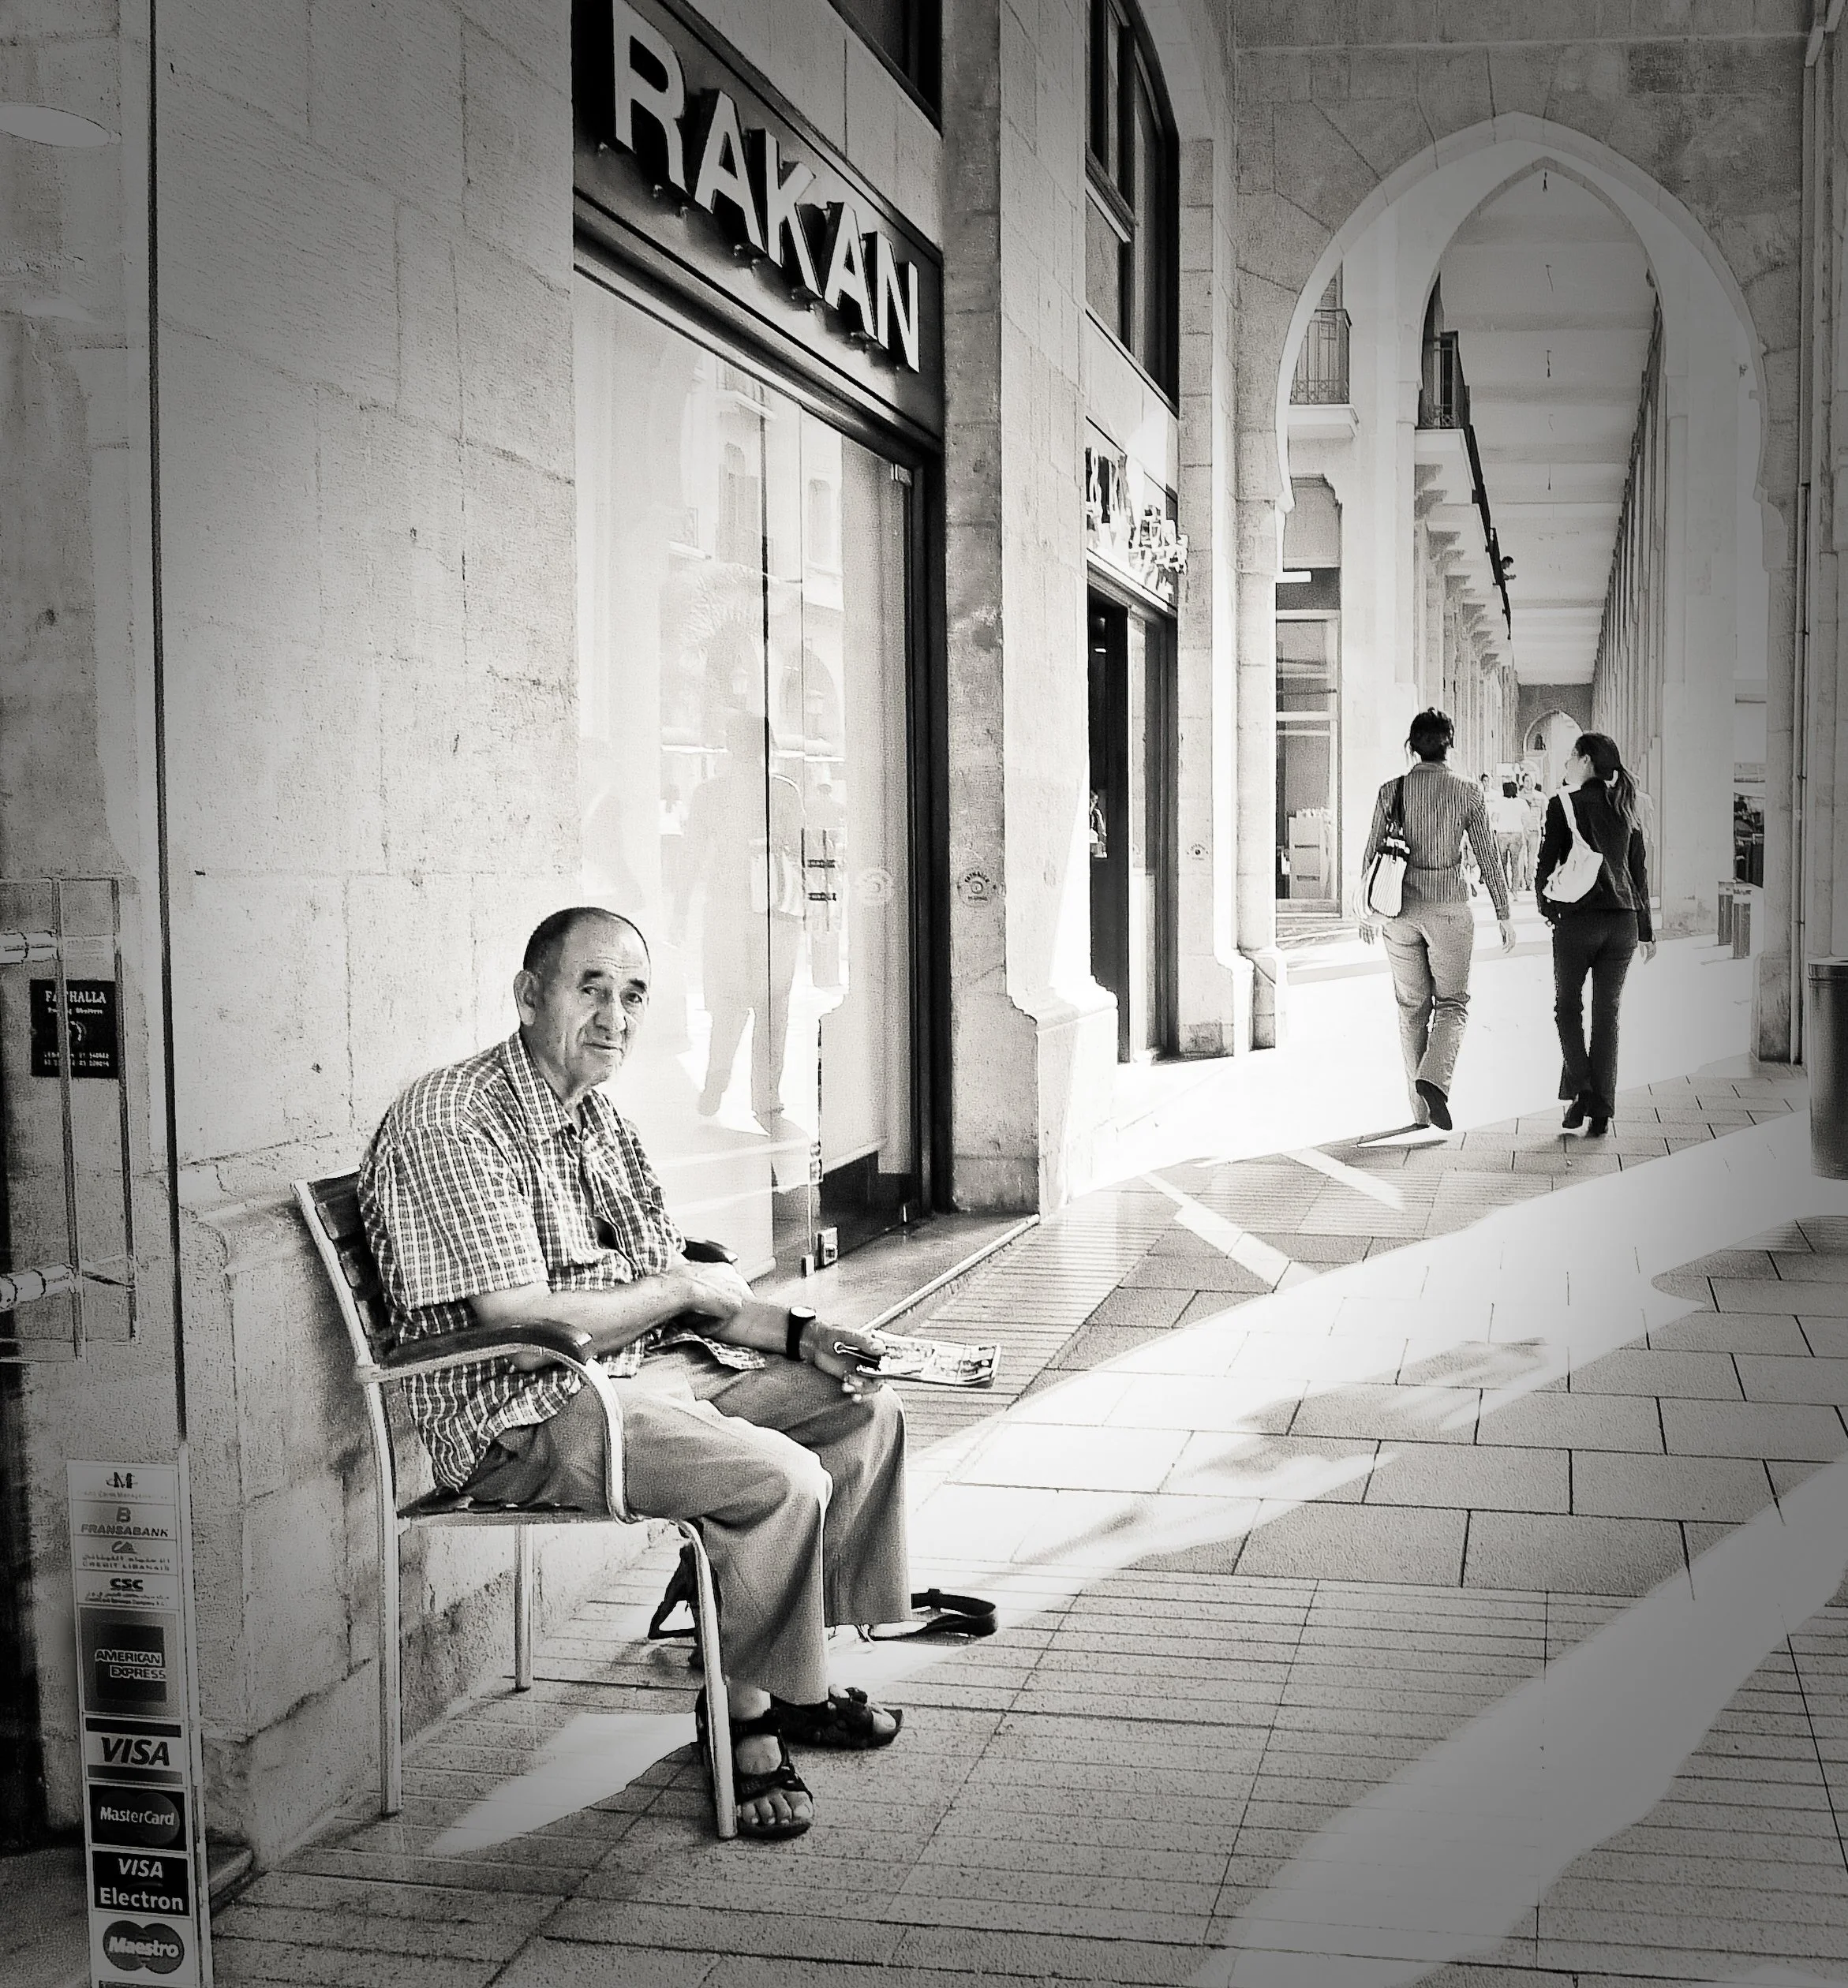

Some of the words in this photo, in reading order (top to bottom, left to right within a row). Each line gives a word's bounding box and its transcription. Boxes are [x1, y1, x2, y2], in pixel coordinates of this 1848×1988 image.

[613, 0, 920, 373] RAKAN
[80, 1523, 169, 1538] FRANSABANK
[109, 1577, 144, 1590] CSC
[95, 1649, 161, 1665] AMERICAN
[110, 1665, 166, 1680] EXPRESS
[100, 1736, 170, 1766] VISA
[100, 1806, 174, 1826] MasterCard
[118, 1858, 163, 1878] VISA
[99, 1886, 184, 1911] Electron
[107, 1936, 180, 1958] Maestro
